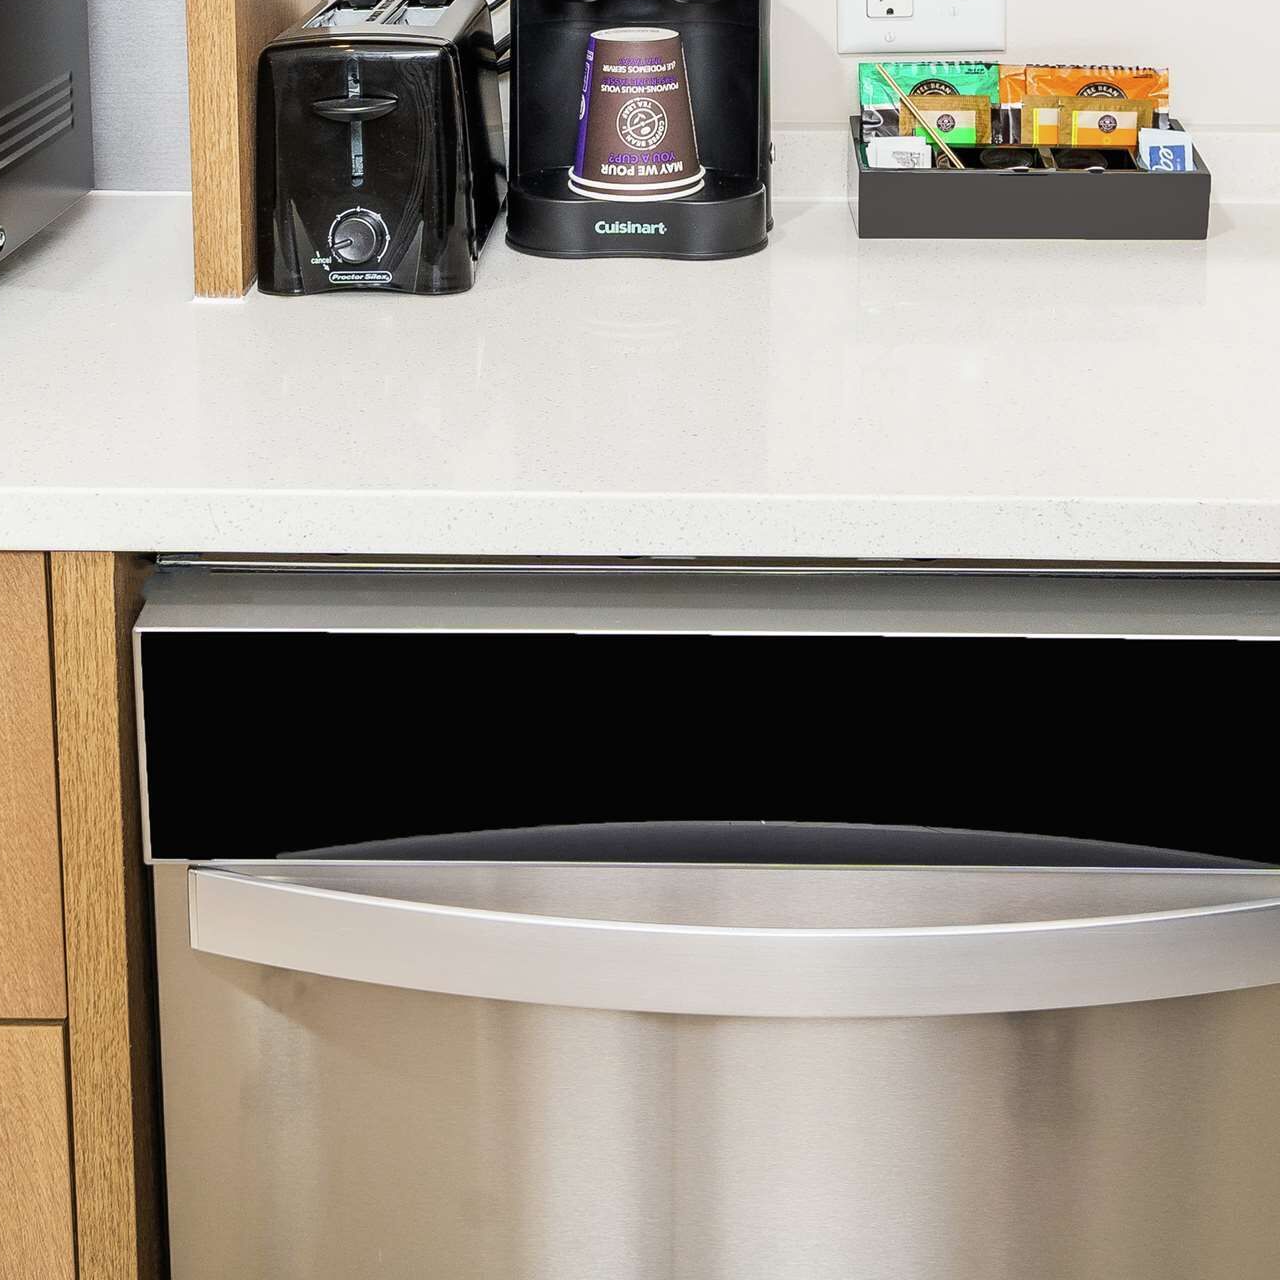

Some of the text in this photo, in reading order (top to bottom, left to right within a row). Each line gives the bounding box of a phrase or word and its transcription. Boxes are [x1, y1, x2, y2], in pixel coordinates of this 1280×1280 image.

[602, 64, 627, 74] SERVIR
[627, 64, 666, 74] PODEMOS
[601, 84, 621, 93] VOUS
[1097, 85, 1119, 97] BEAN
[621, 102, 637, 119] LEAF
[625, 120, 665, 147] COFFEE BEAN
[608, 151, 675, 164] YOU A CUP?
[601, 161, 683, 176] MAY WE POUR
[595, 221, 665, 234] Cuisinart
[311, 256, 332, 265] cancel
[332, 273, 363, 281] Proctor
